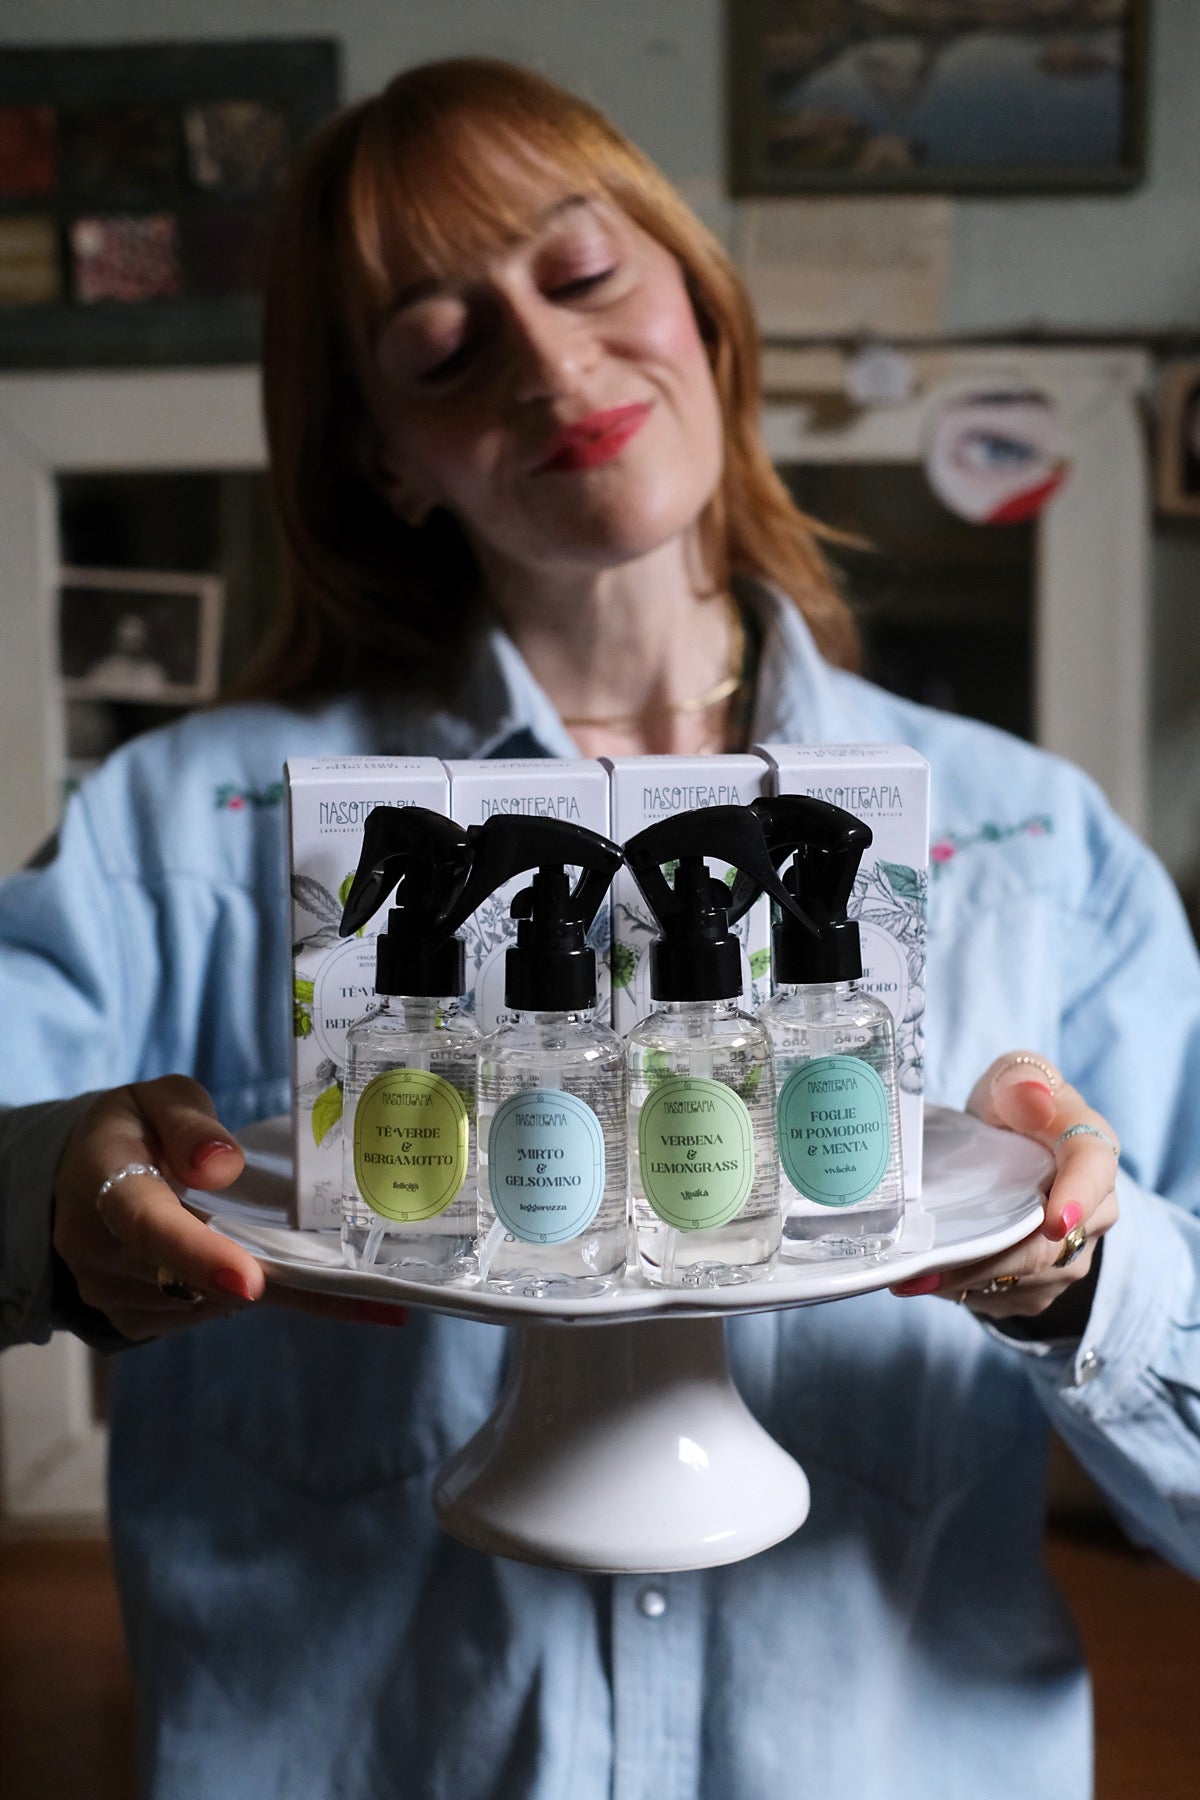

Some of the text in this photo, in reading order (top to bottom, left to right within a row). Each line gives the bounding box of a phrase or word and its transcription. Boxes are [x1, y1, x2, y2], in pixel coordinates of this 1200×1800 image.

[643, 785, 741, 810] NASOTERAPIA
[807, 1078, 859, 1094] NASOTERAPIA
[382, 1092, 434, 1107] NASOTERAPIA
[663, 1100, 715, 1114] NASOTERAPIA
[515, 1113, 568, 1127] NASOTERAPIA
[810, 1107, 857, 1122] FOGLIE
[376, 1125, 441, 1139] TÈ VERDE
[790, 1120, 880, 1140] DI POMODORO
[660, 1134, 724, 1146] VERBENA
[401, 1142, 412, 1153] &
[517, 1148, 565, 1161] MIRTO
[686, 1149, 697, 1160] &
[807, 1140, 869, 1156] & MENTA
[363, 1152, 453, 1166] BERGAMOTTO
[536, 1163, 547, 1174] &
[651, 1160, 739, 1174] LEMONGRASS
[505, 1175, 582, 1187] GELSOMINO
[519, 1203, 568, 1213] leggerezza
